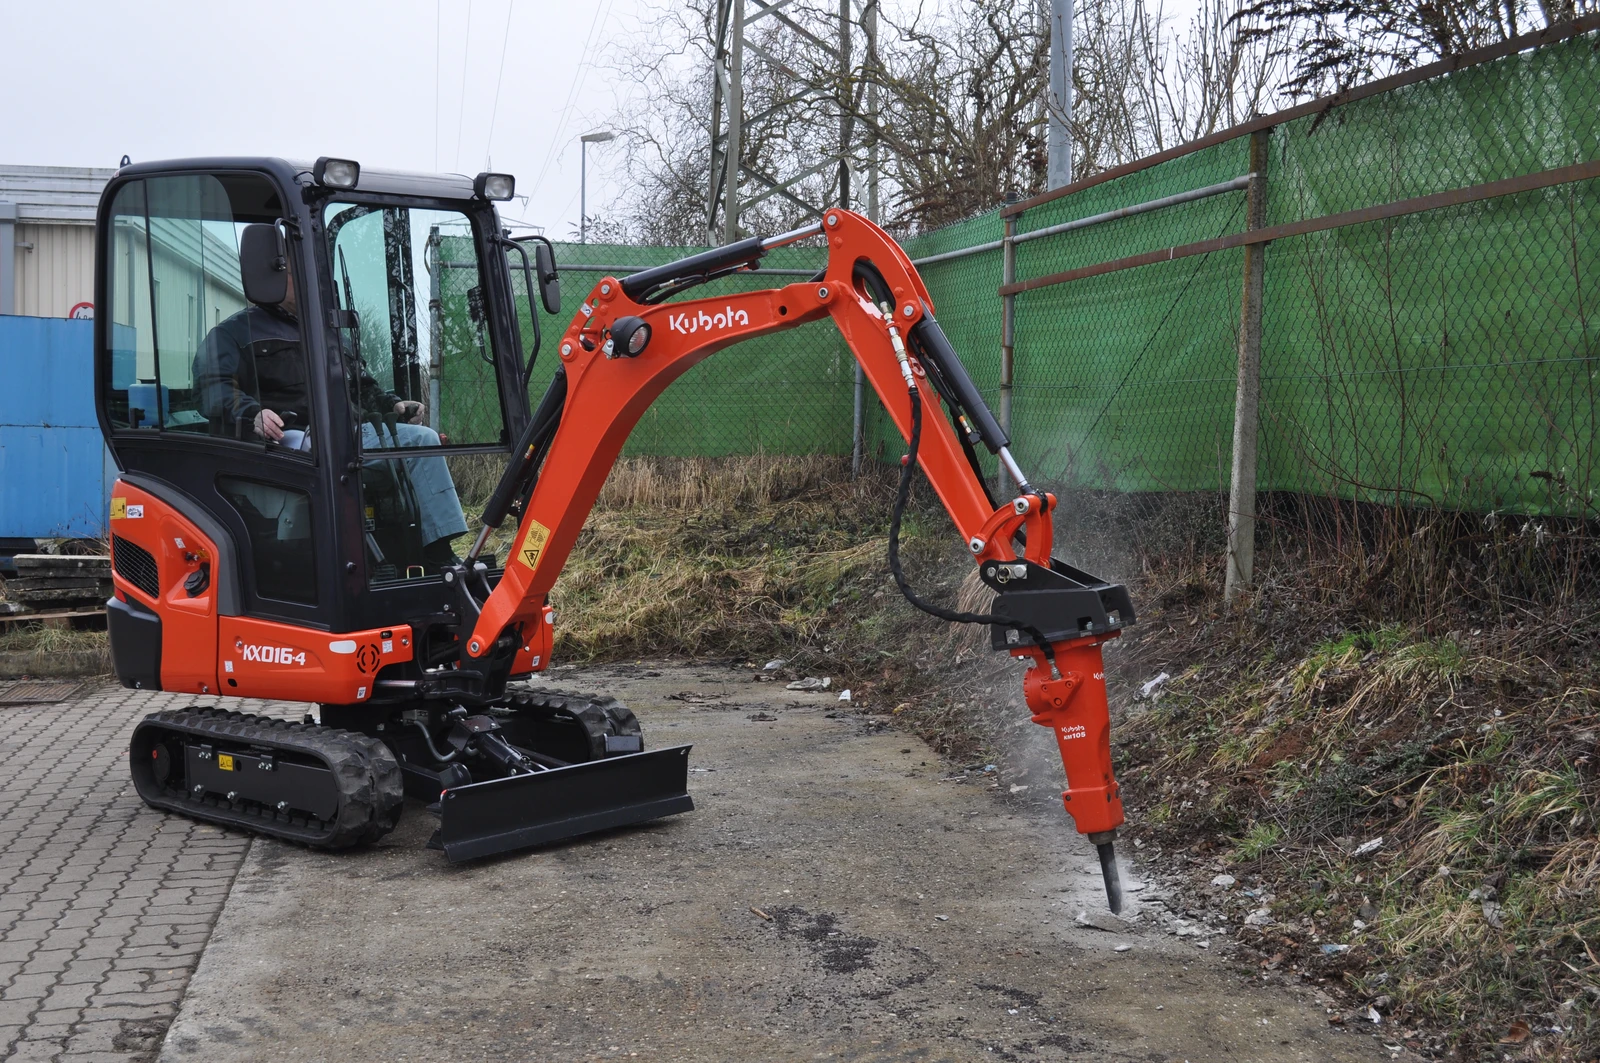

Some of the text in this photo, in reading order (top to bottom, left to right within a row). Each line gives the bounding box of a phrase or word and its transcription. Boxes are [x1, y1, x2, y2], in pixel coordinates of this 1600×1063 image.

[669, 306, 749, 335] Kubota
[1061, 724, 1085, 733] Kubota
[1063, 731, 1086, 740] KM105
